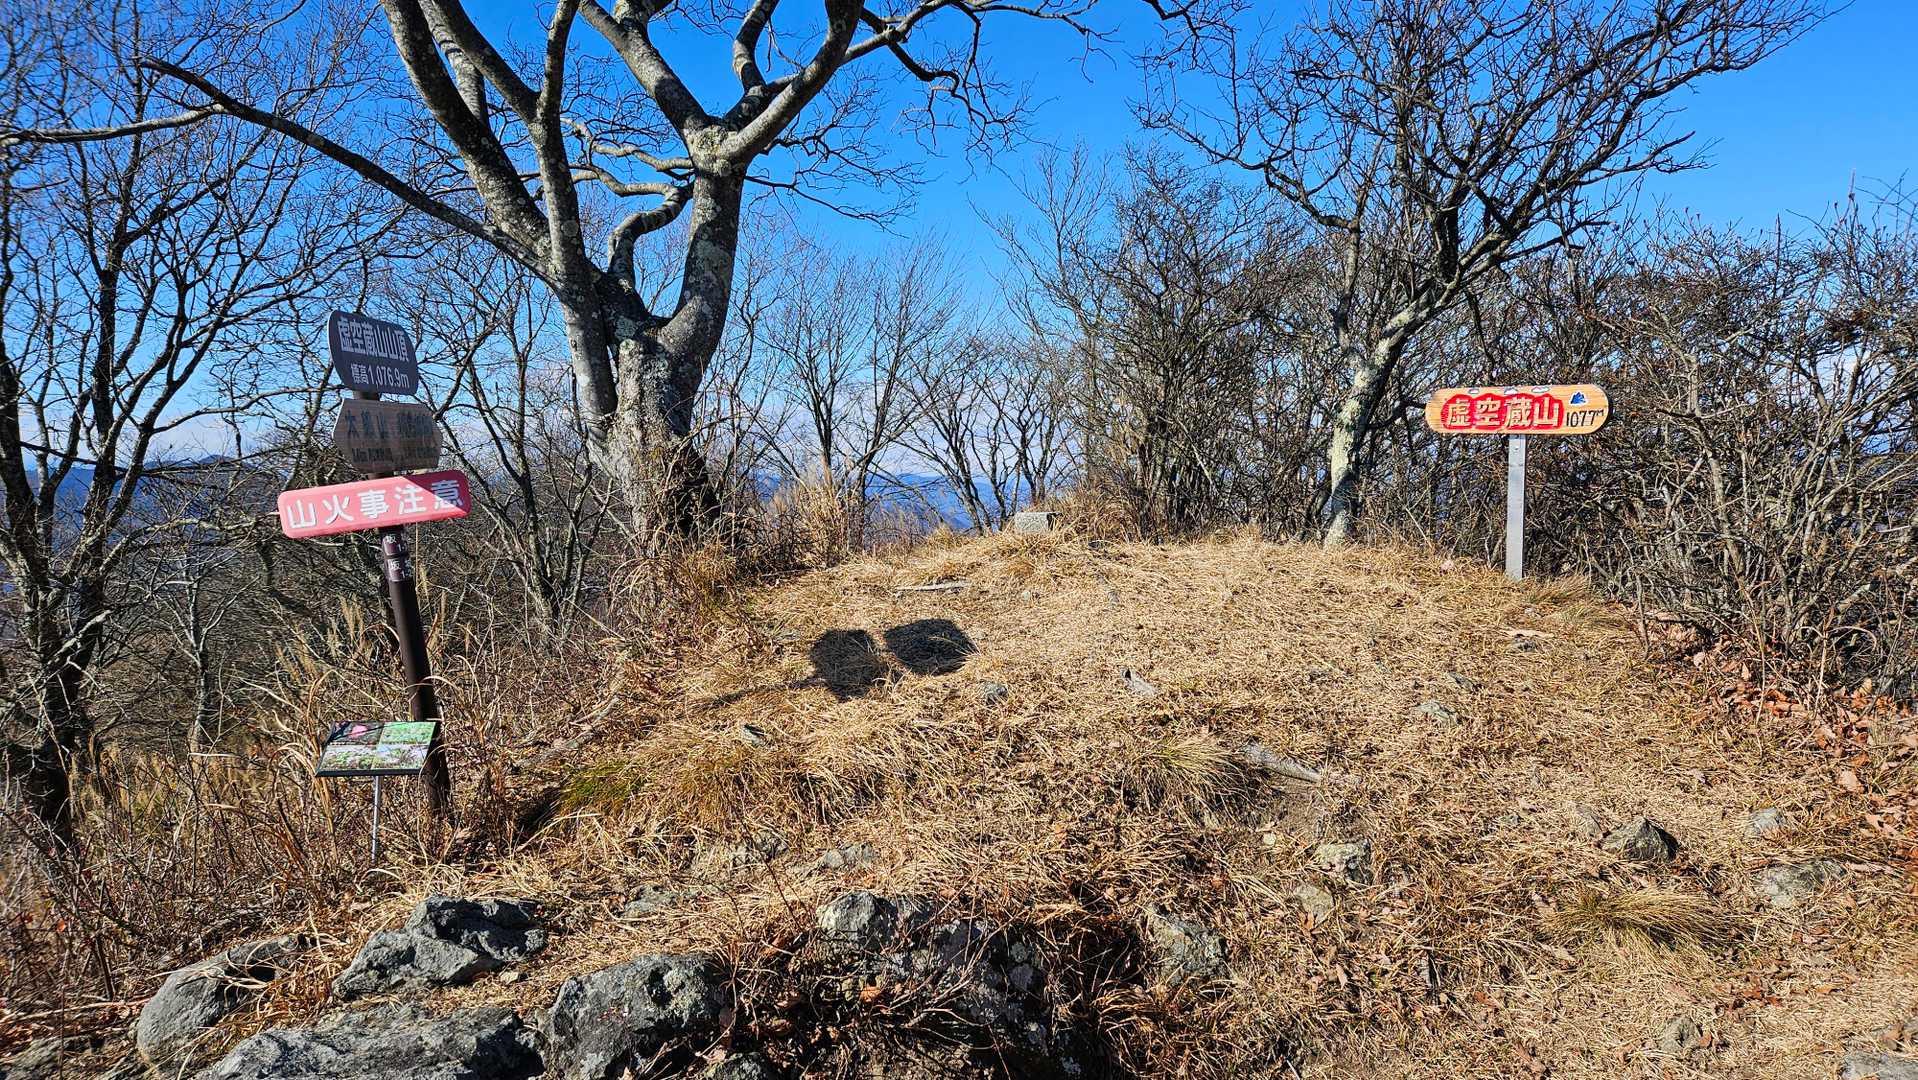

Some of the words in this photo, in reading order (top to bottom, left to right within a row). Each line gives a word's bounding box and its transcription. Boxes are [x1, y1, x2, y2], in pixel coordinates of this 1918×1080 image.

[1448, 396, 1560, 427] 虚空蔵山
[287, 479, 464, 528] 山火事注意
